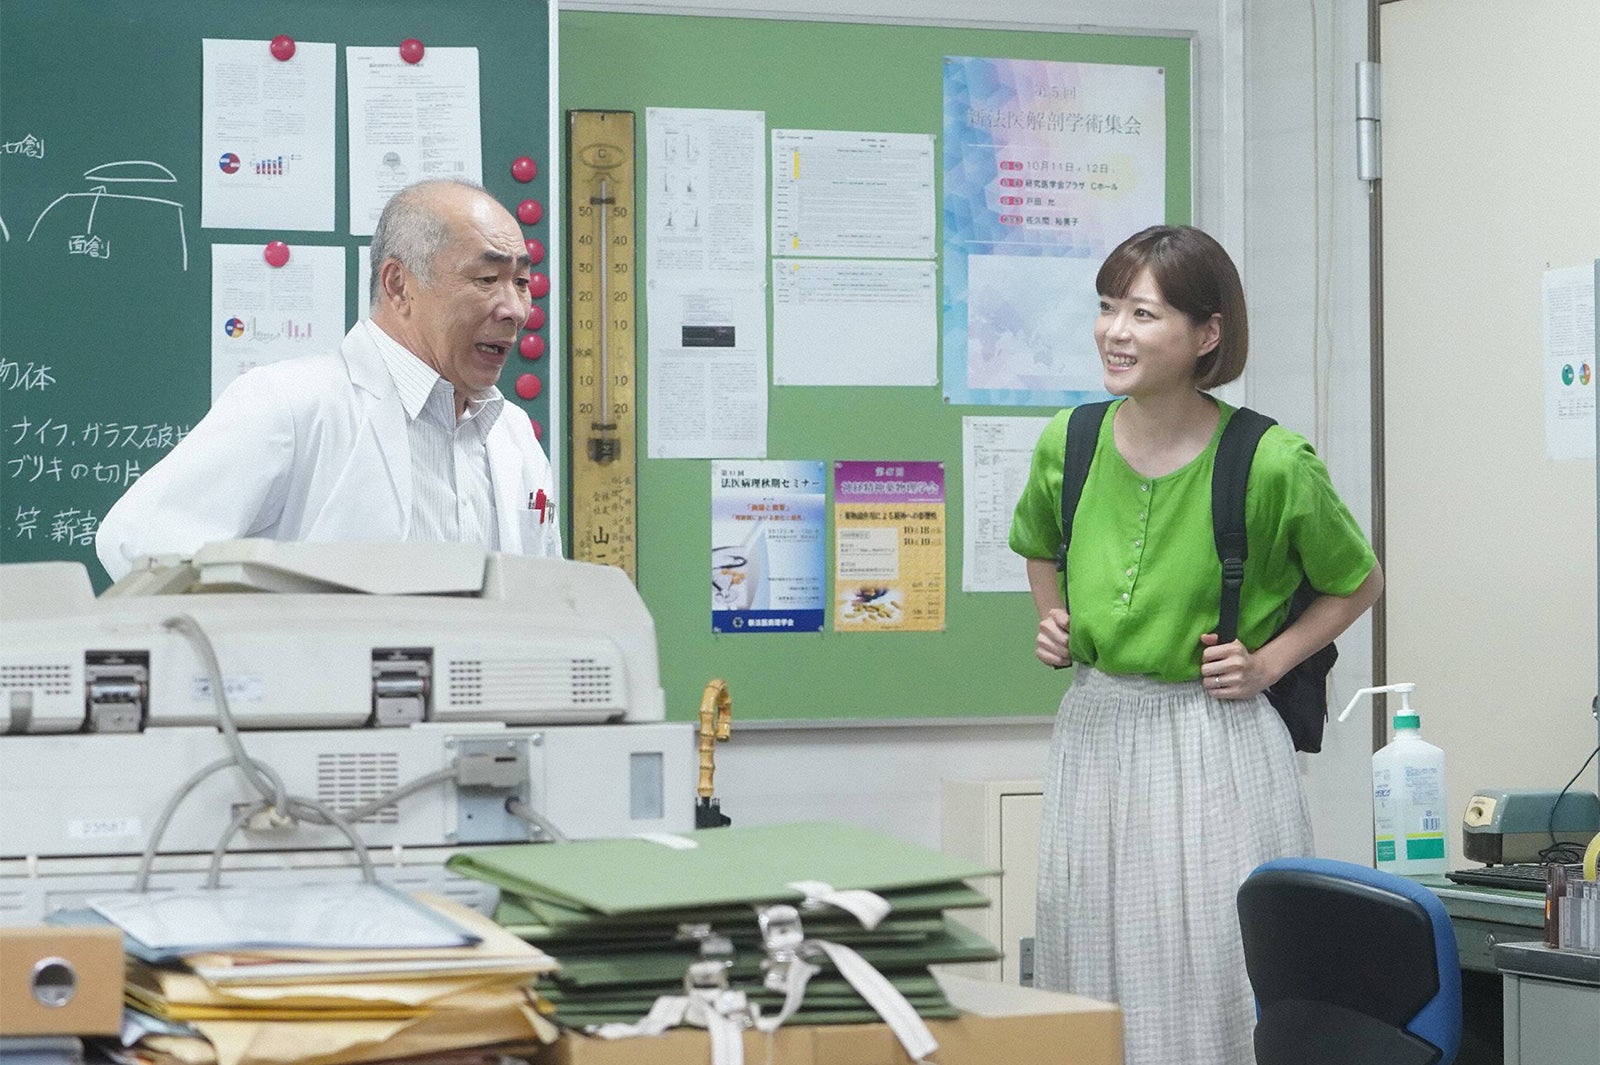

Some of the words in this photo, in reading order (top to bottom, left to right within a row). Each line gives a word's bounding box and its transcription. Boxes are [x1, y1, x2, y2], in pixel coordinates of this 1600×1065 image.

[578, 206, 593, 217] 50
[613, 206, 628, 217] 50
[578, 235, 593, 246] 40
[613, 235, 628, 246] 40
[578, 262, 593, 274] 30
[613, 262, 628, 274] 30
[578, 290, 593, 302] 20
[613, 290, 628, 302] 20
[579, 319, 593, 330] 10
[614, 319, 628, 330] 10
[579, 375, 593, 386] 10
[614, 375, 628, 386] 10
[579, 403, 593, 414] 20
[614, 403, 628, 414] 20
[593, 525, 610, 566] 山一
